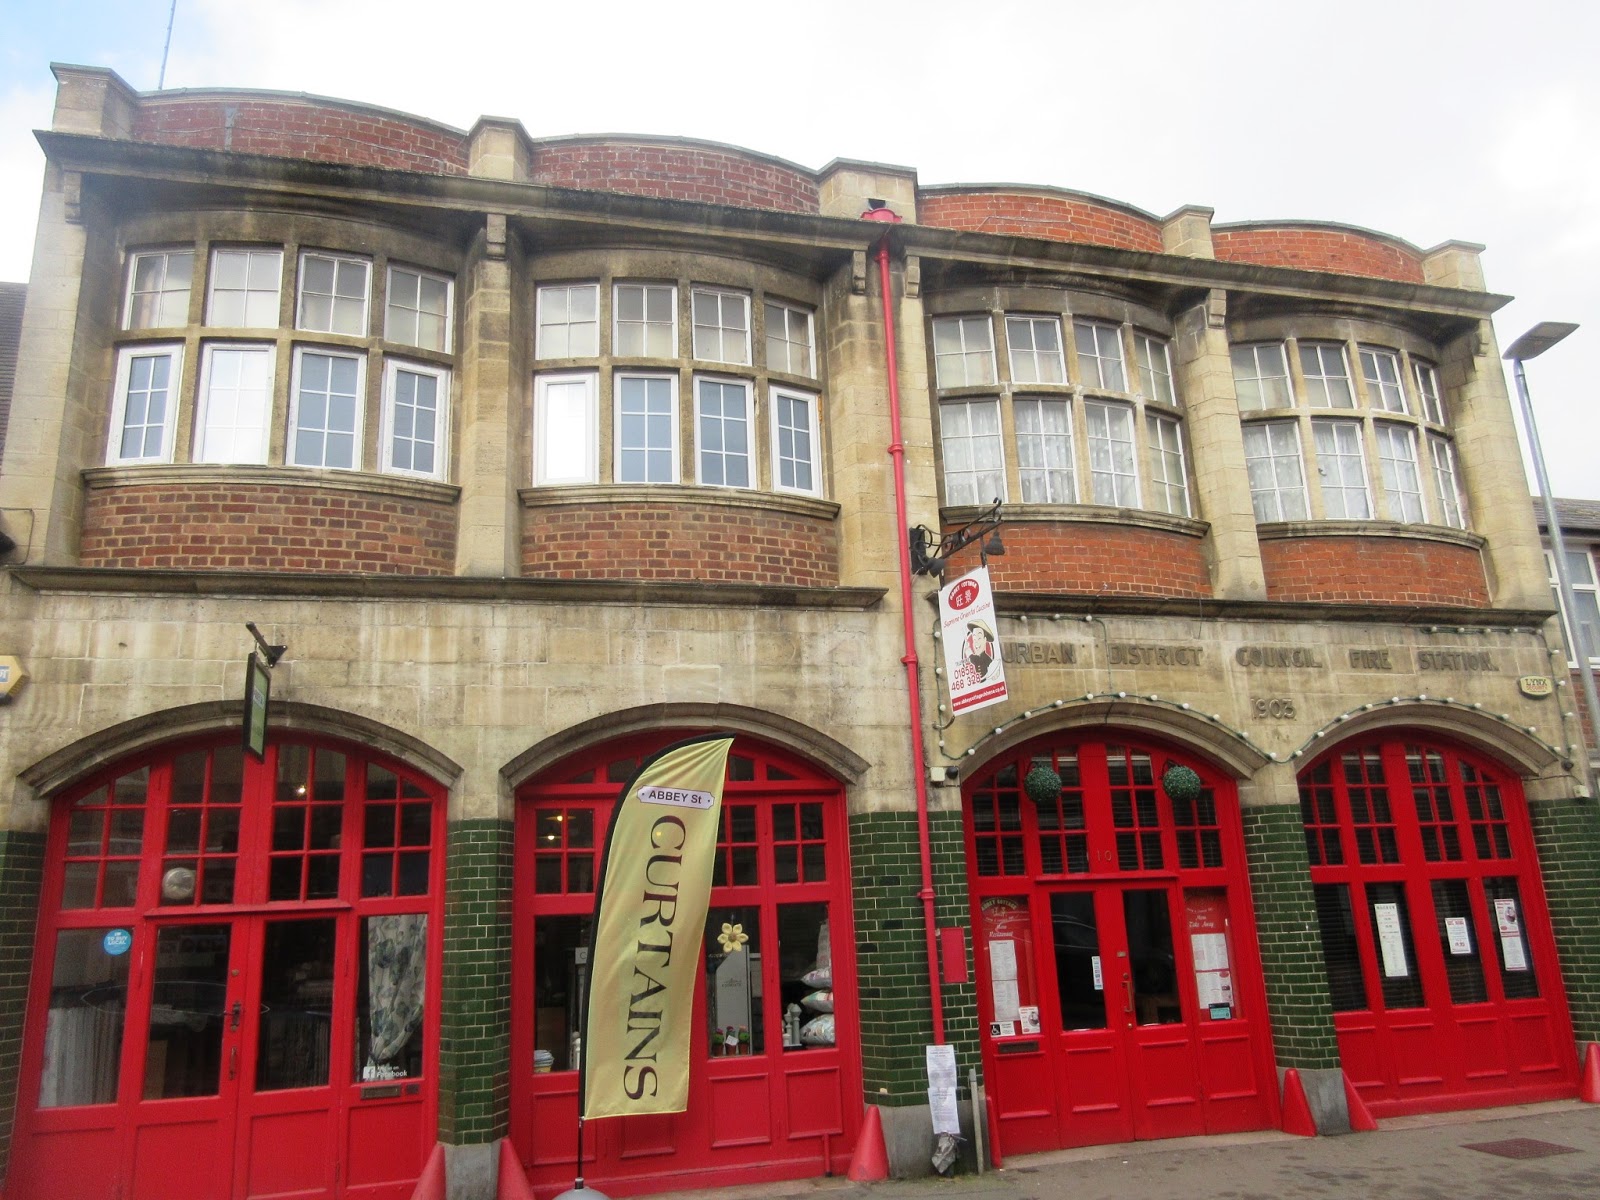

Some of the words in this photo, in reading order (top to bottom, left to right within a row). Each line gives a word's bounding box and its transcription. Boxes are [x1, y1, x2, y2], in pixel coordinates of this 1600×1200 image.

[1000, 642, 1077, 665] URBAN
[1108, 643, 1204, 667] DISTRICT
[1235, 646, 1323, 669] COUNCIL
[1350, 649, 1393, 670] FIRE
[1417, 651, 1500, 672] STATION
[951, 679, 965, 691] 468
[966, 673, 981, 687] 328
[1524, 678, 1548, 686] LYNX
[1250, 698, 1297, 720] 1903
[648, 790, 689, 802] ABBEY
[691, 794, 702, 804] St
[623, 814, 686, 1100] CURTAINS
